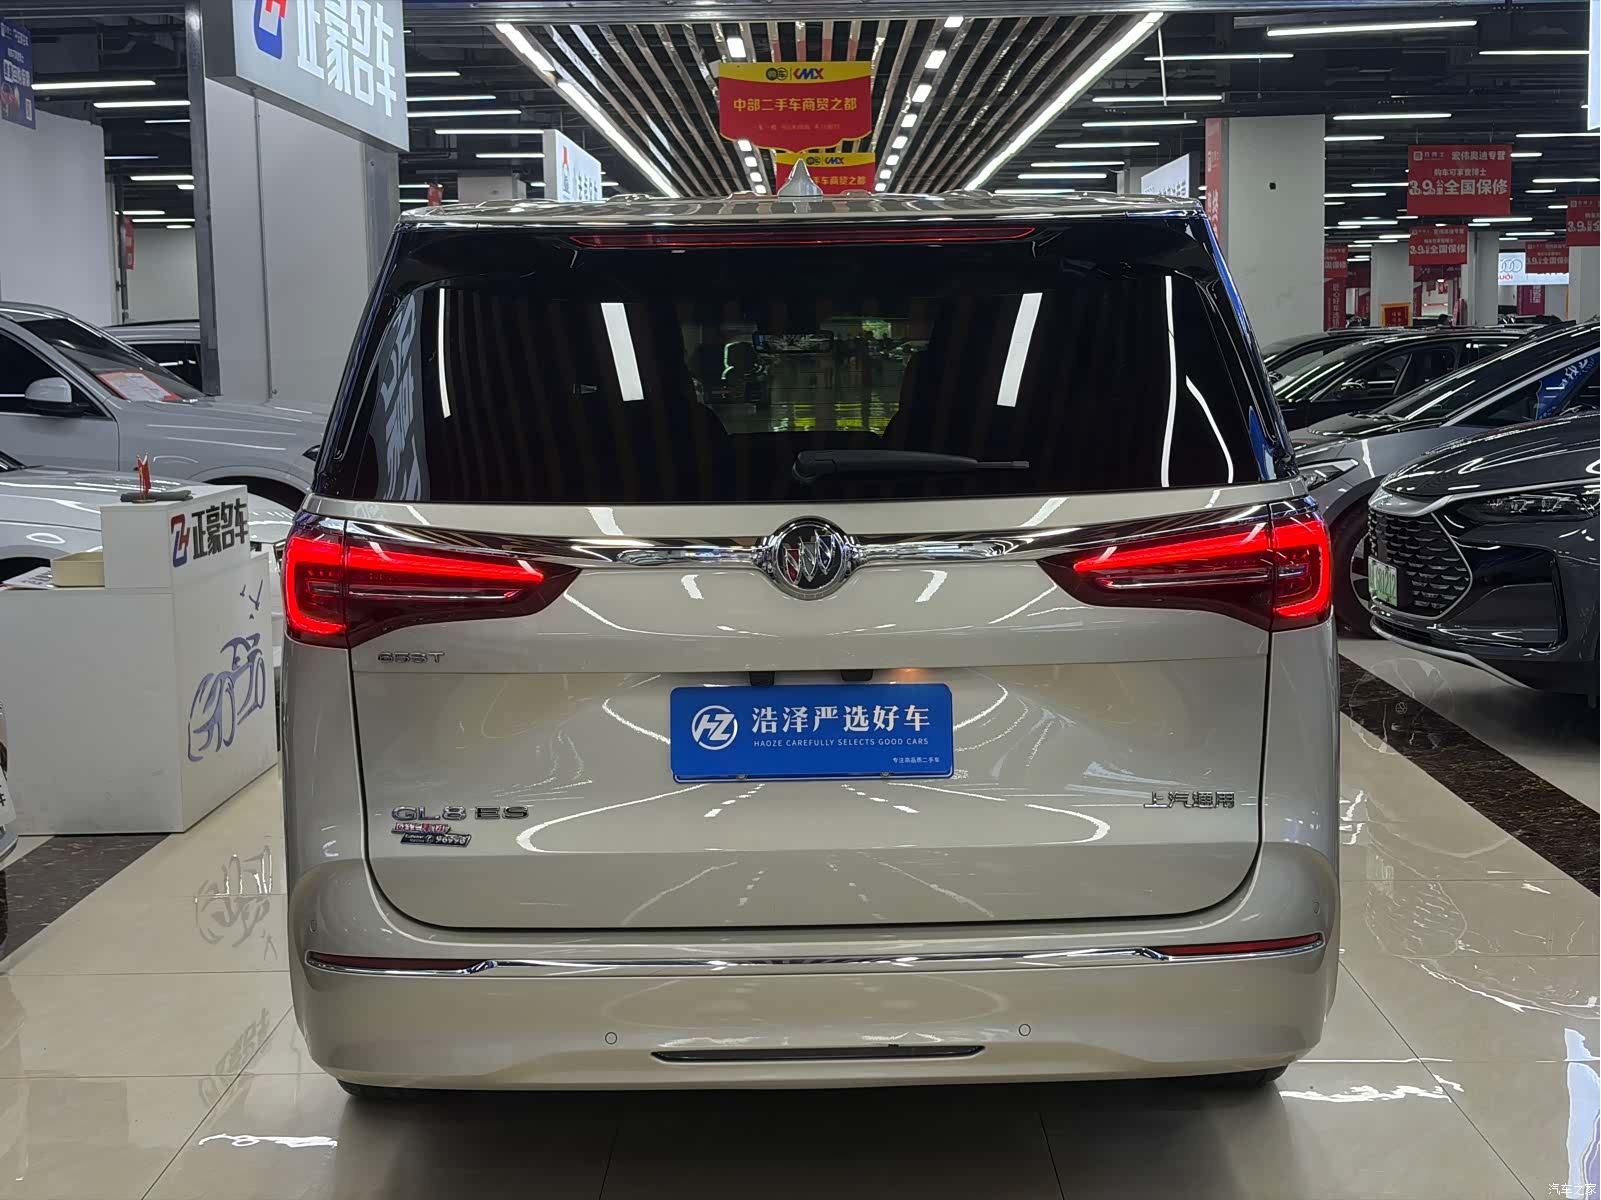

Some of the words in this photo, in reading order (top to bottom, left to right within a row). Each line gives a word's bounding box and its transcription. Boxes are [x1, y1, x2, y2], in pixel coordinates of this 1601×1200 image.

[733, 98, 857, 112] 中部二手车商贸之都
[191, 498, 249, 560] 正豪名车
[752, 705, 930, 733] 浩泽严选好车
[785, 739, 835, 747] CAREFULLY
[838, 738, 875, 746] SELECTS
[878, 738, 903, 746] GOOD
[906, 737, 929, 745] CARS
[1143, 791, 1235, 809] 上汽通用
[391, 806, 467, 821] GL8
[475, 805, 529, 820] ES
